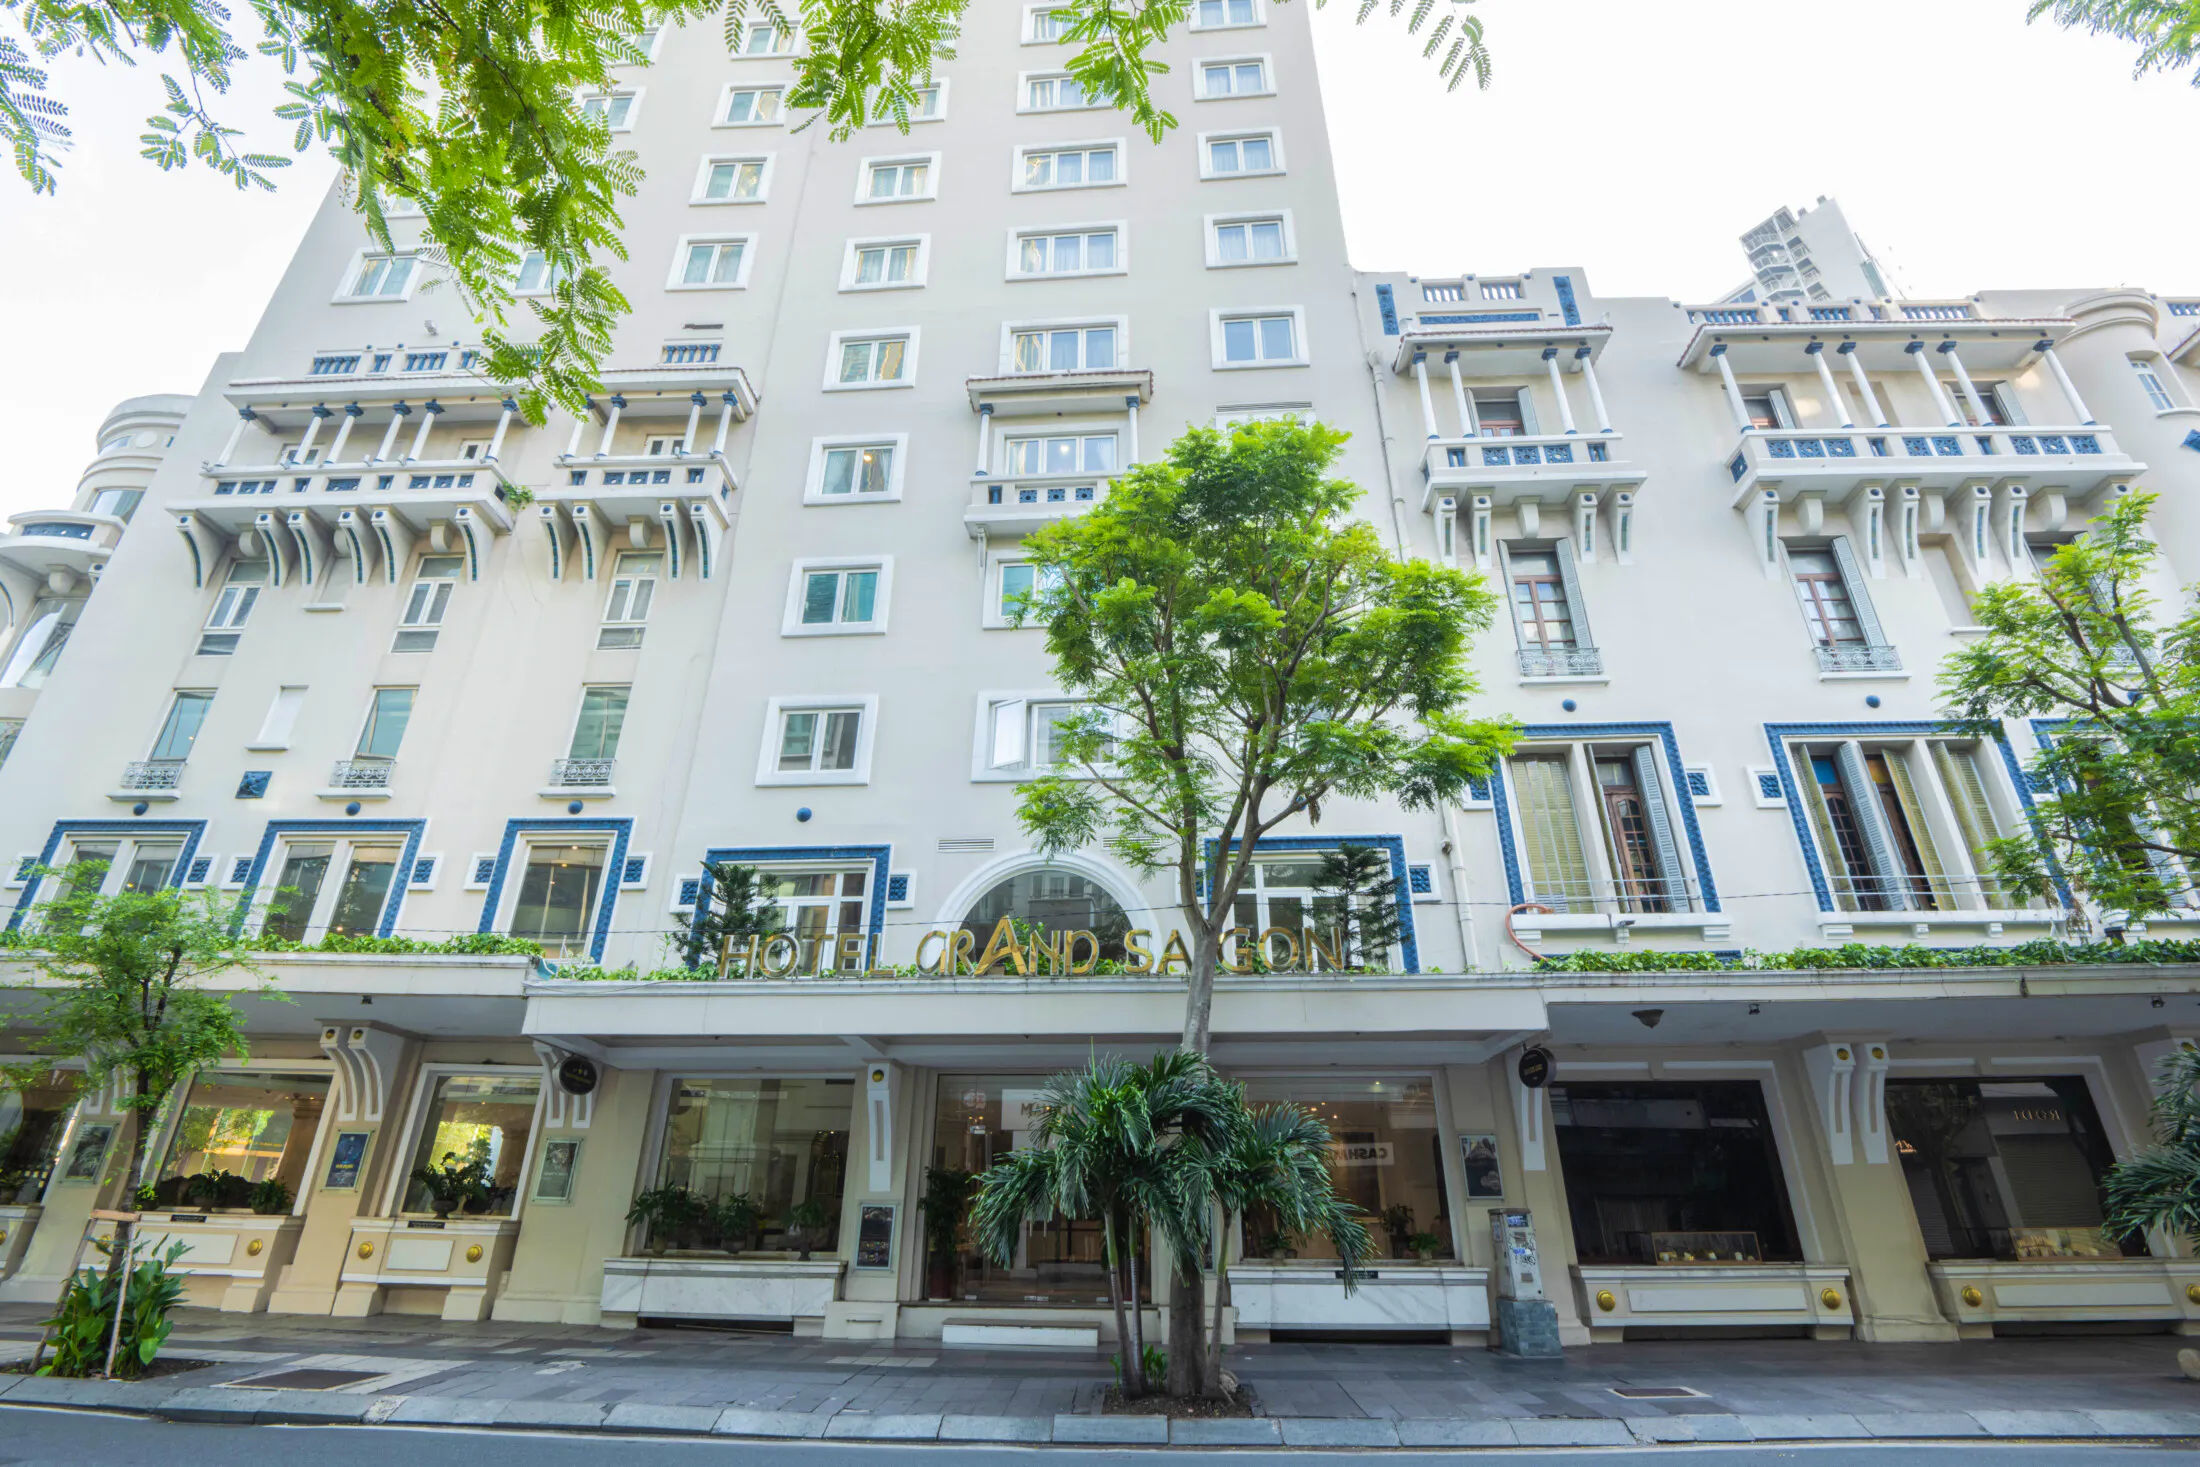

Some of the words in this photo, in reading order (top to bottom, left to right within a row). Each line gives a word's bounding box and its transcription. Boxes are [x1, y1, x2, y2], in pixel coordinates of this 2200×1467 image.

[718, 932, 898, 980] HOTEL
[915, 914, 1101, 977] GRAND
[1122, 926, 1345, 976] SAGON
